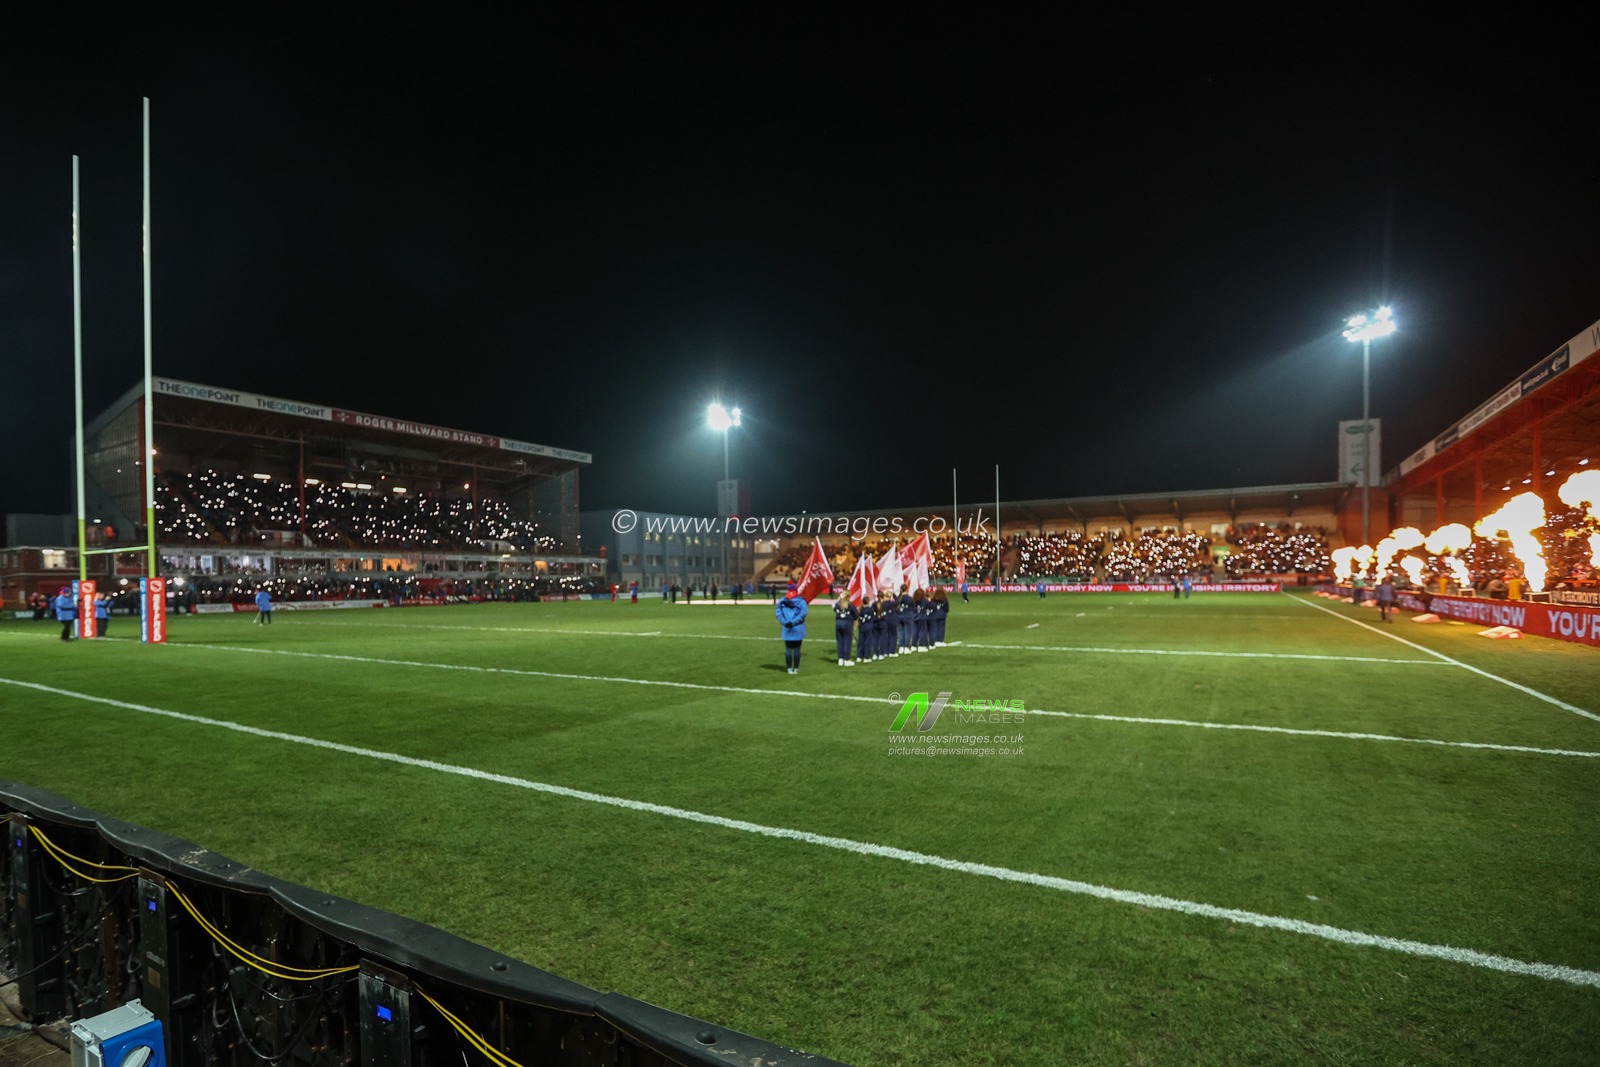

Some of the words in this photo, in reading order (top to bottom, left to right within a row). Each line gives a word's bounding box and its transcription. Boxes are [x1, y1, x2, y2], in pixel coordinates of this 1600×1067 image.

[356, 415, 394, 430] ROGER
[397, 422, 450, 440] MILLWARD
[452, 432, 483, 445] STAND
[1492, 605, 1526, 627] NOW
